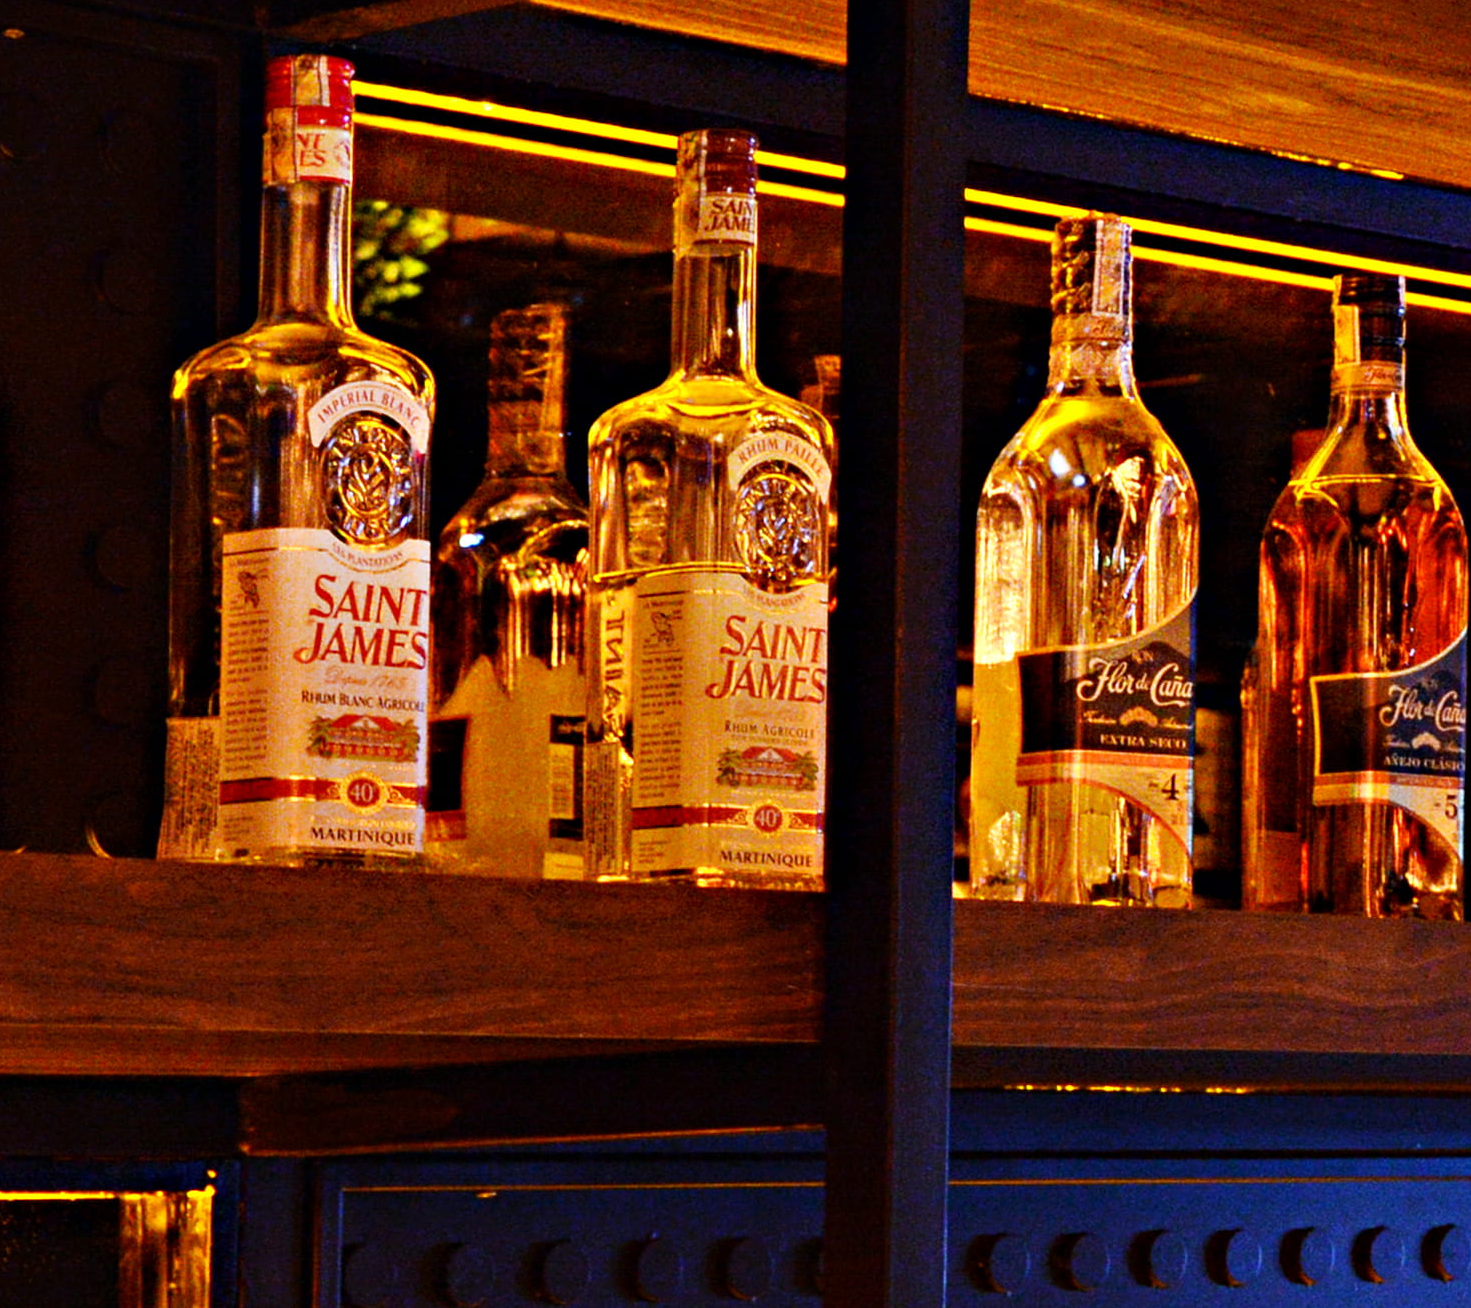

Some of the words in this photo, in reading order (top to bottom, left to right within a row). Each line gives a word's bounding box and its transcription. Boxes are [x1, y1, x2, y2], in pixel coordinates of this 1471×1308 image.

[317, 390, 375, 423] IMPERIAL
[381, 392, 421, 427] BLANC
[308, 573, 428, 627] SAINT
[292, 622, 428, 670] JAMES
[719, 614, 827, 664] SAINT
[704, 659, 827, 705] JAMES
[1076, 656, 1135, 702] Flor
[1150, 662, 1194, 708] Caña
[1379, 684, 1424, 727] Flor
[1100, 733, 1146, 747] EXTRA
[1149, 736, 1188, 750] SECO
[310, 826, 416, 846] MARTINIQUE
[719, 849, 814, 868] MARTINIQUE
